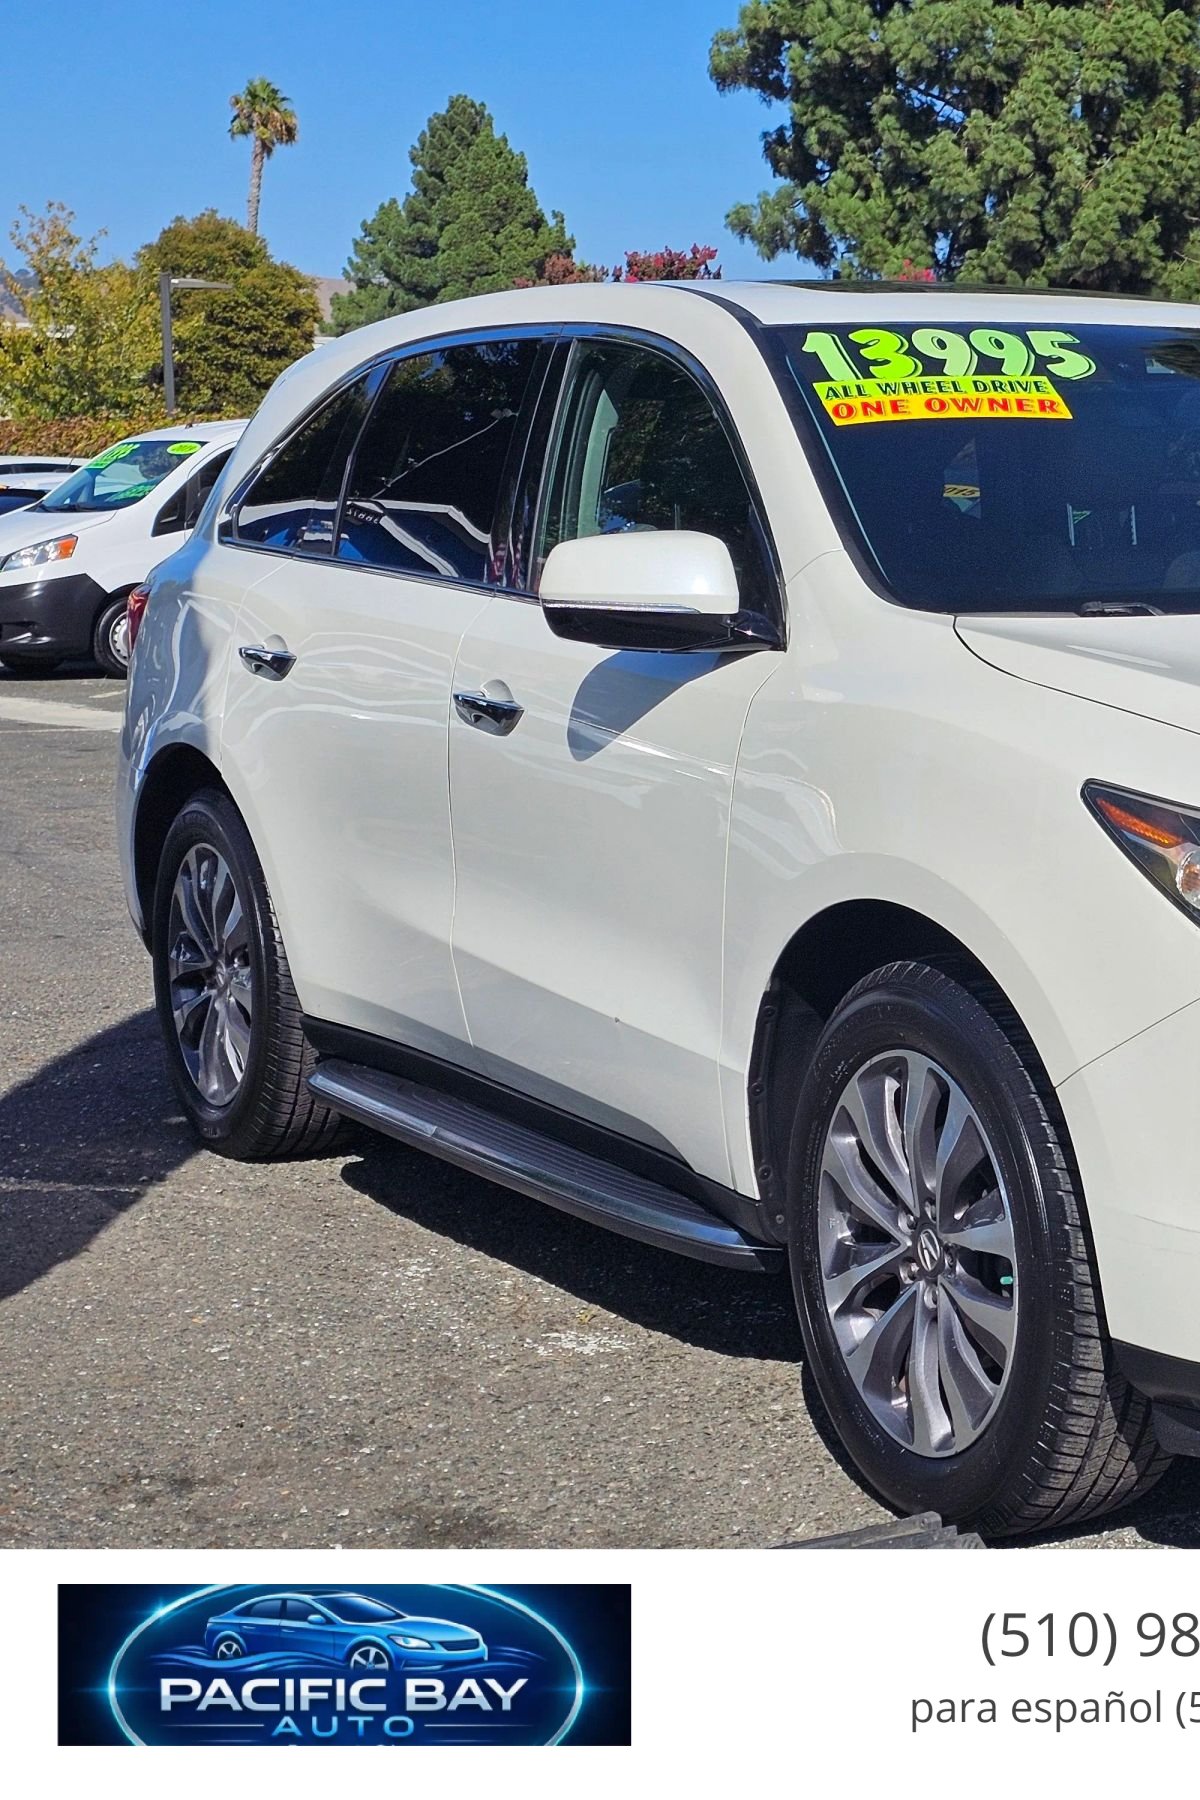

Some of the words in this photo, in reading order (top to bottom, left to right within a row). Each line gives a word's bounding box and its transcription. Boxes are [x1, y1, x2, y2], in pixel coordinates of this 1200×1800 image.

[802, 328, 1096, 381] 13995
[824, 384, 869, 401] ALL
[876, 380, 964, 397] WHEEL
[973, 378, 1048, 394] DRIVE
[831, 399, 911, 420] ONE
[923, 396, 1062, 414] OWNER
